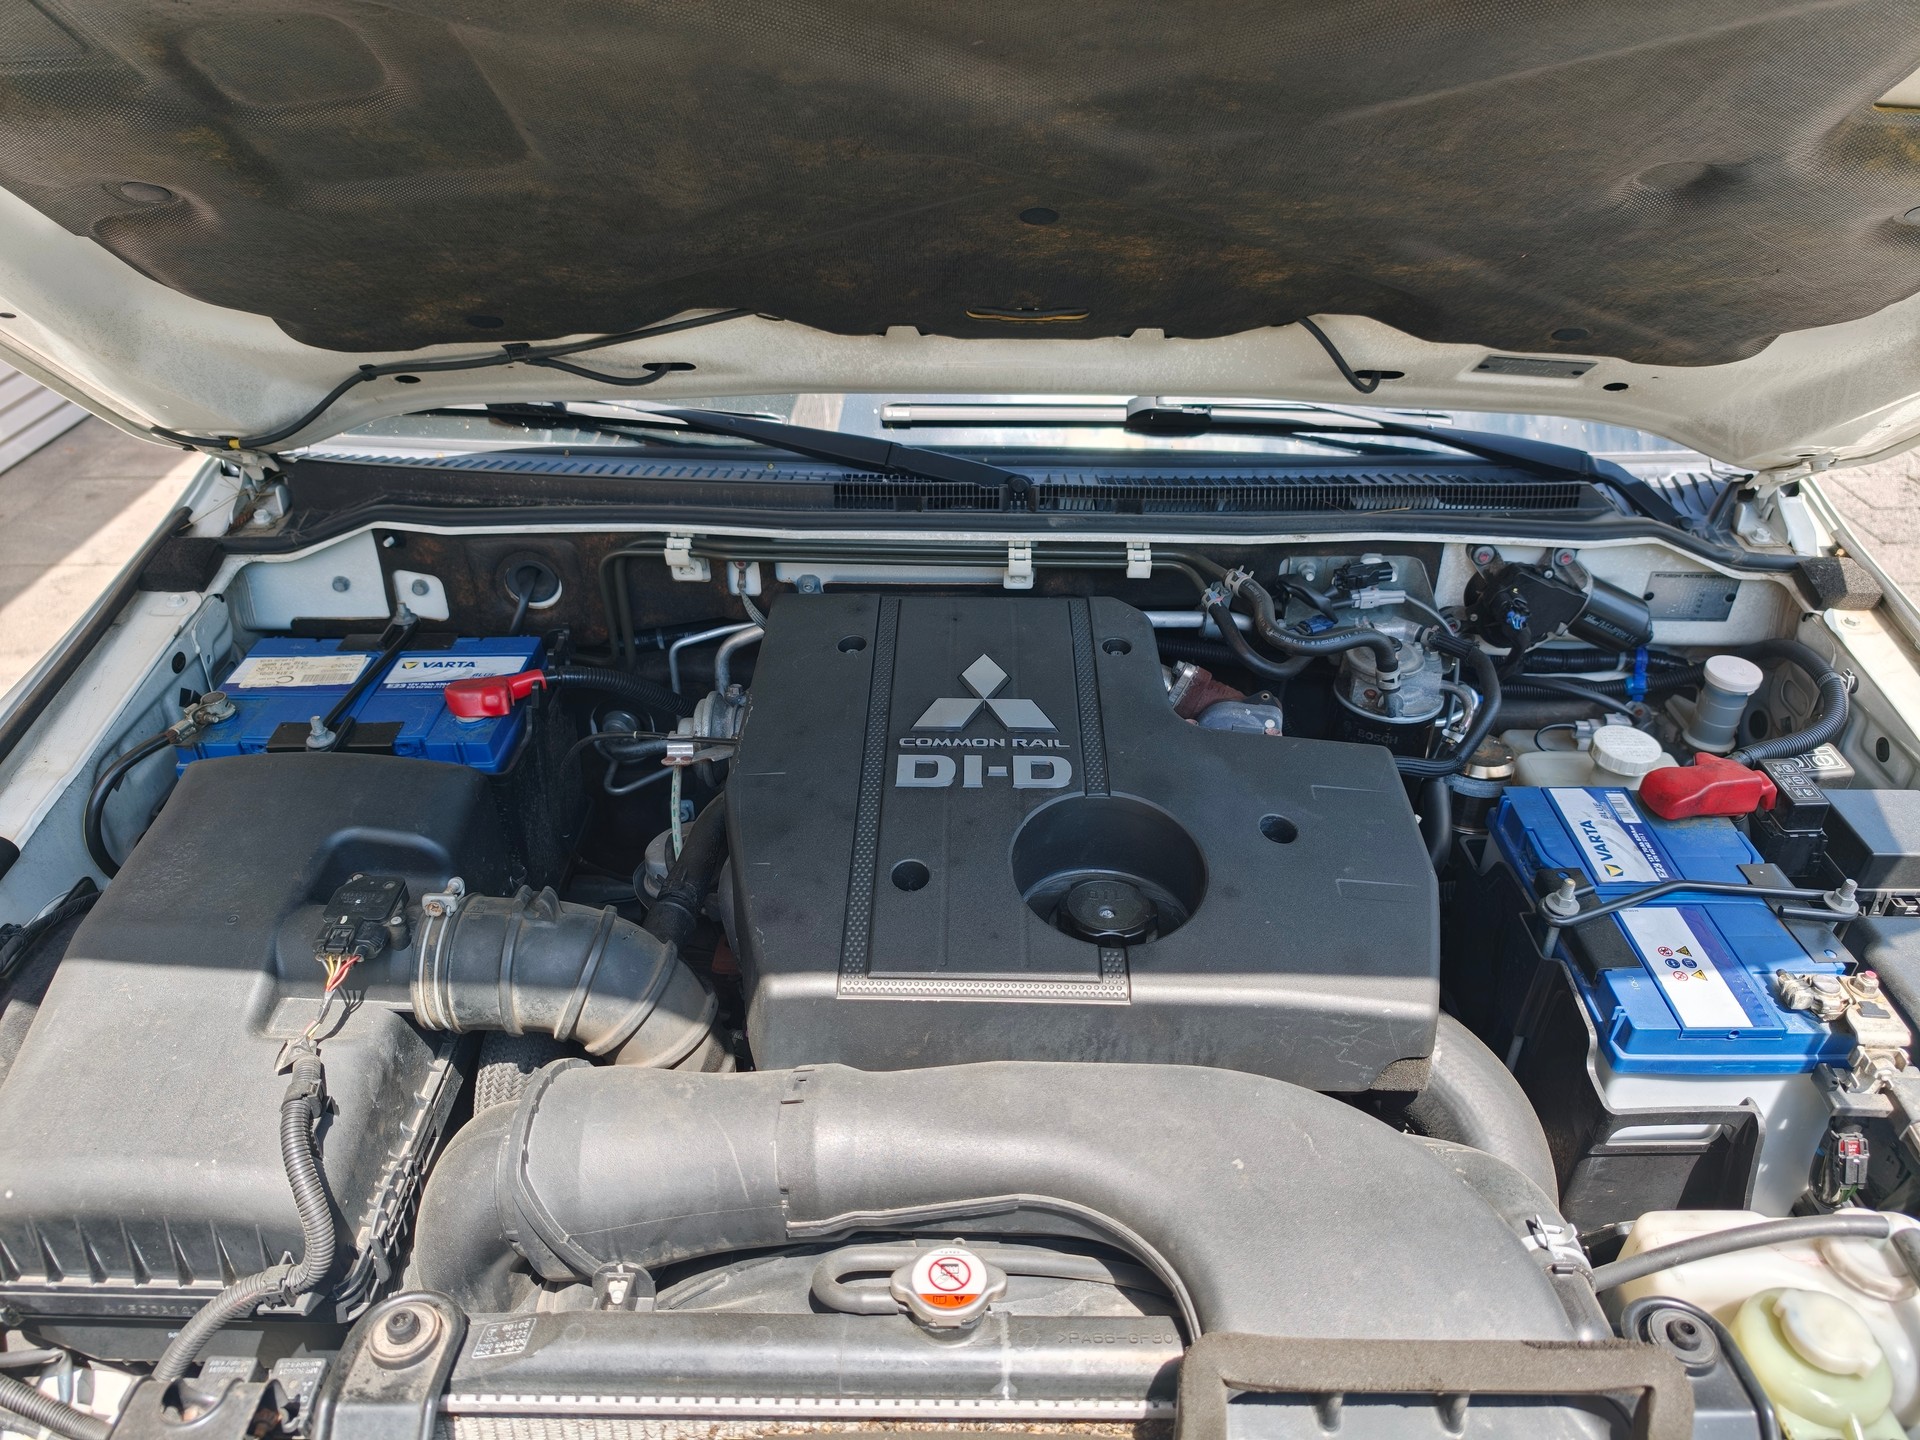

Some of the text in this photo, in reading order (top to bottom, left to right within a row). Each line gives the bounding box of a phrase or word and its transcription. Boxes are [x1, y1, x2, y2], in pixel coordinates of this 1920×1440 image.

[423, 661, 476, 669] VARTA
[899, 738, 1070, 749] COMMON RAIL
[1357, 728, 1399, 744] BOSCH
[895, 754, 1073, 789] DI-D
[1592, 802, 1609, 820] BLUE
[1579, 819, 1613, 861] VARTA
[1646, 853, 1655, 862] 12V
[1652, 862, 1669, 879] E23
[1088, 888, 1124, 901] OIL
